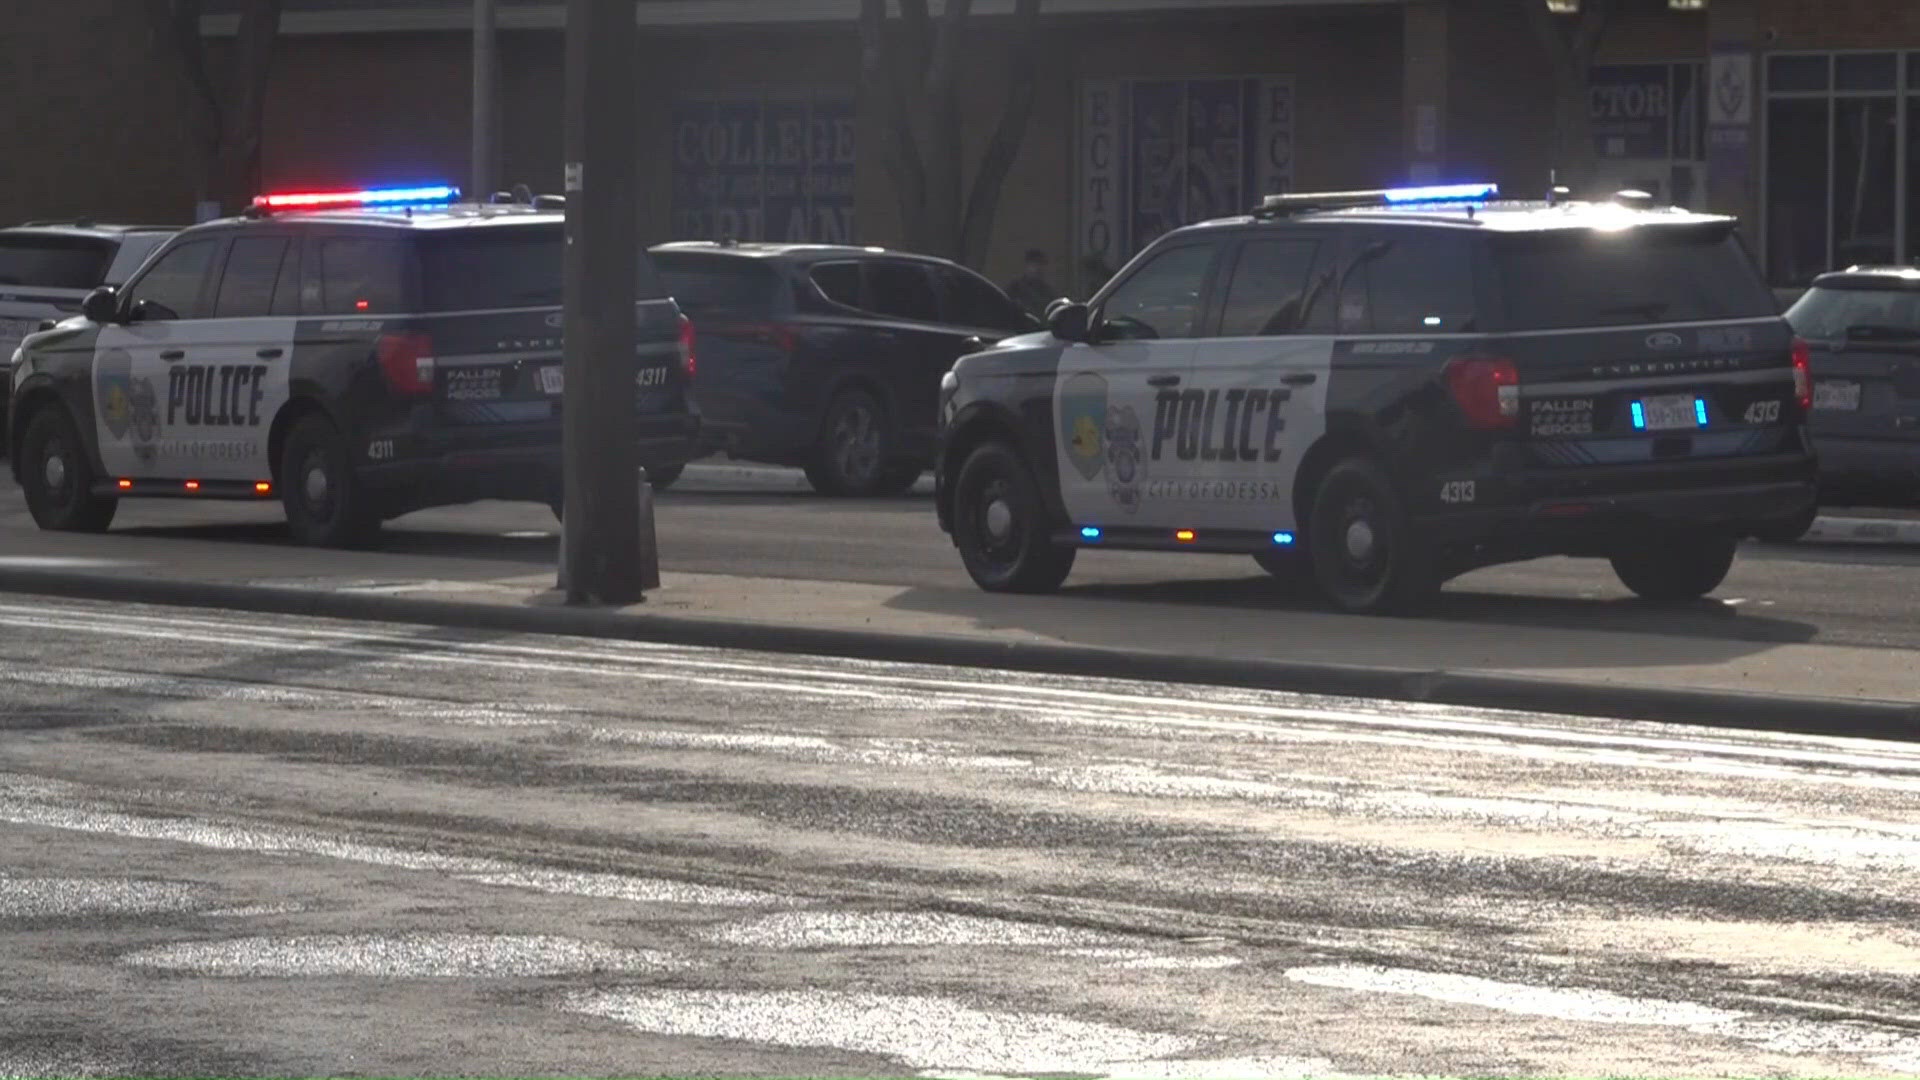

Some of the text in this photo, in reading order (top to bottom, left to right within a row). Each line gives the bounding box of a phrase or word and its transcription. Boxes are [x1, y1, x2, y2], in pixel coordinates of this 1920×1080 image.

[678, 118, 856, 166] COLLEGE
[448, 368, 501, 379] FALLEN
[636, 367, 667, 386] 4311
[167, 365, 268, 426] POLICE
[448, 388, 501, 400] HEROES
[1531, 400, 1593, 412] FALLEN
[1744, 400, 1780, 423] 4313
[1151, 389, 1291, 462] POLICE
[1531, 423, 1593, 436] HEROES
[368, 440, 394, 459] 4311
[1149, 480, 1280, 500] CITY OF ODESSA
[1440, 480, 1475, 503] 4313
